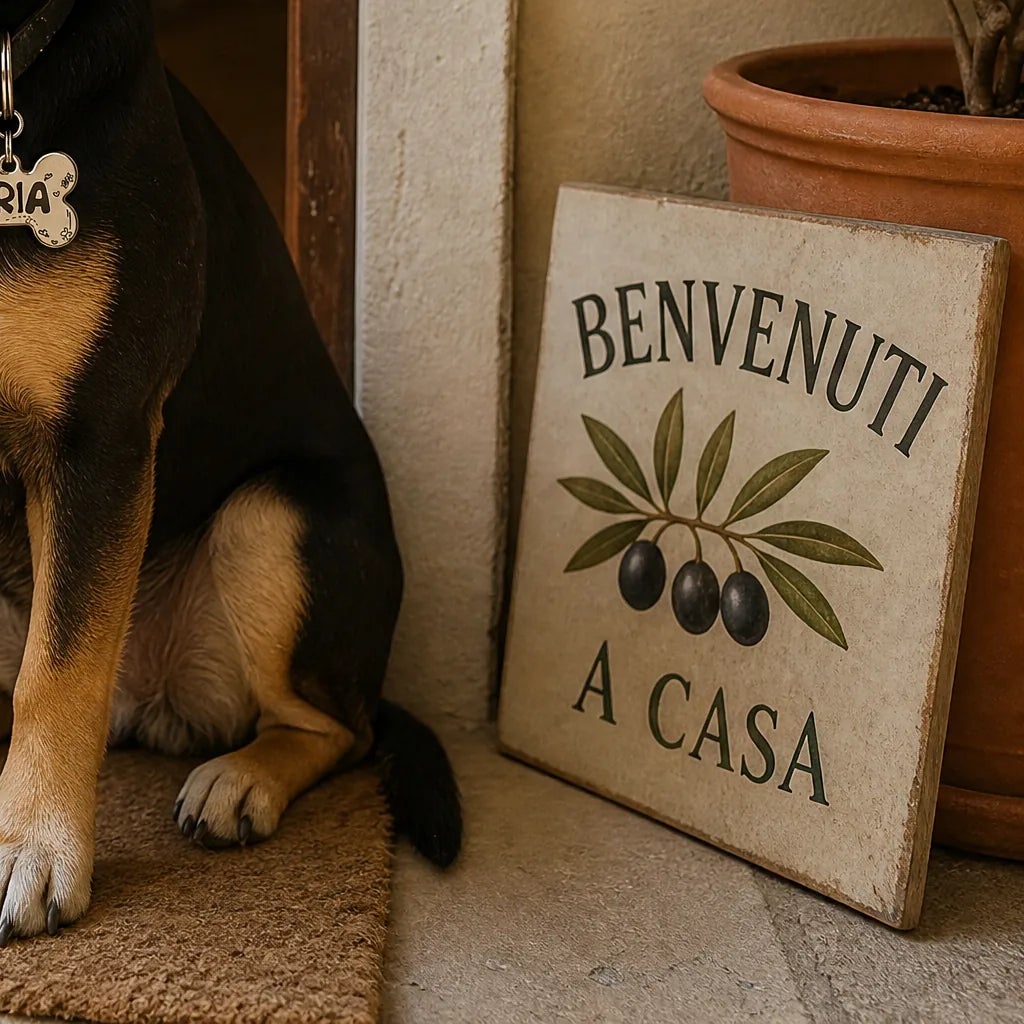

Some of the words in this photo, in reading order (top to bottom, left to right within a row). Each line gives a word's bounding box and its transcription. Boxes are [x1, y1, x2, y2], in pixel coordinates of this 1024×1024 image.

[572, 280, 949, 458] BENVENUTI
[573, 640, 617, 724] A
[648, 673, 829, 806] CASA
